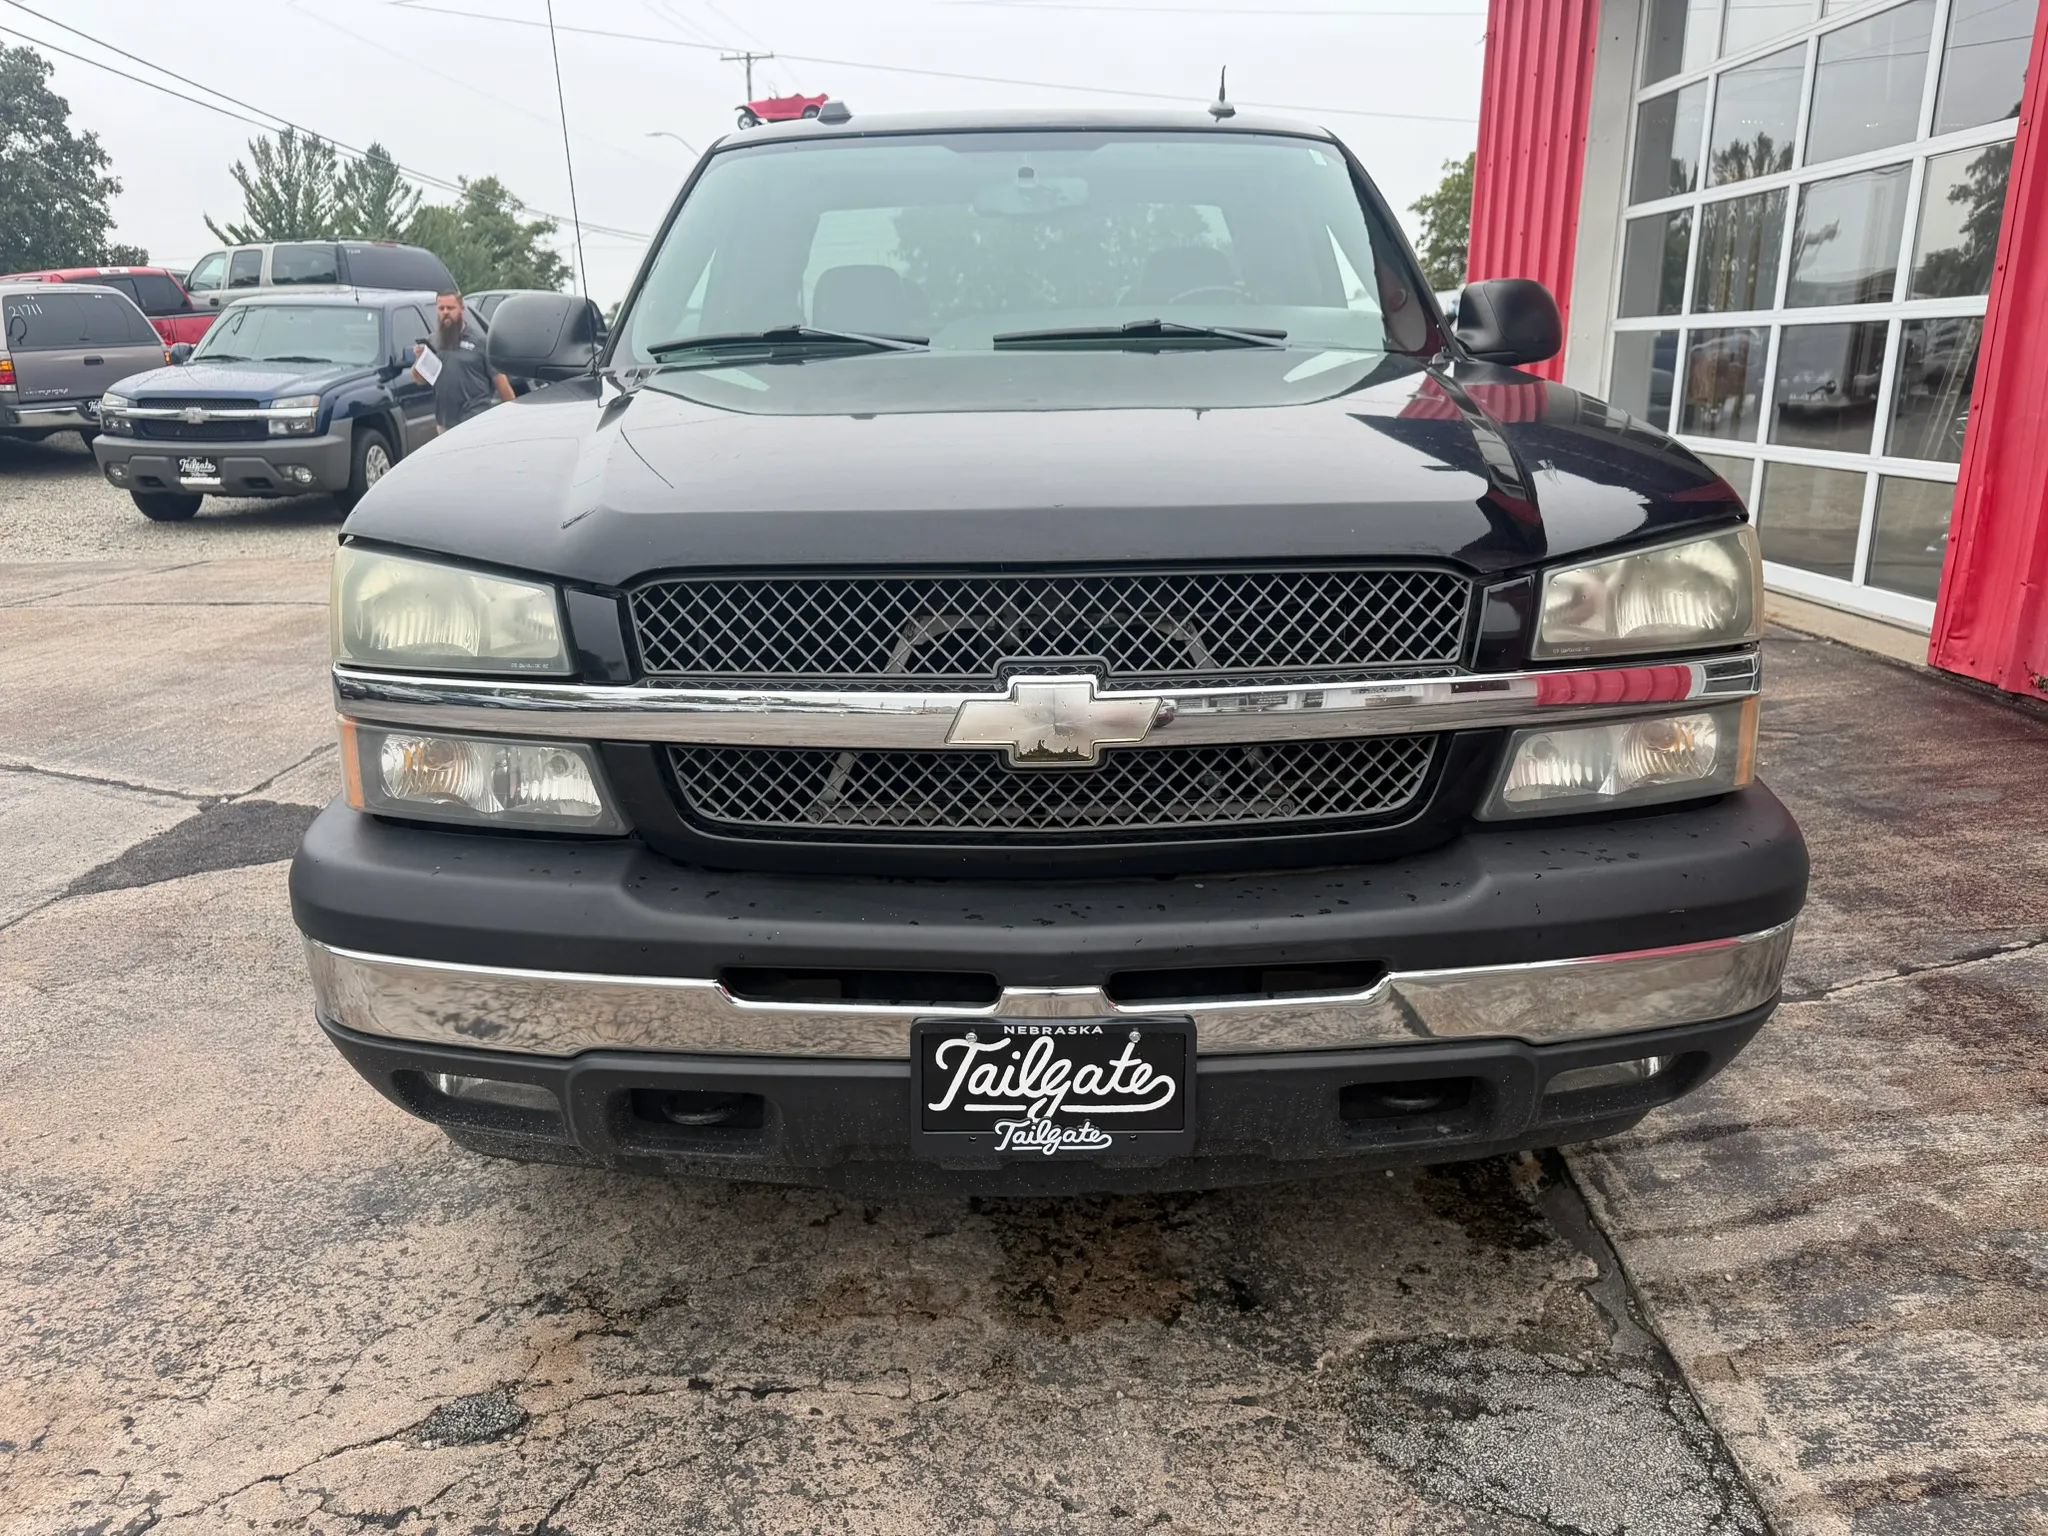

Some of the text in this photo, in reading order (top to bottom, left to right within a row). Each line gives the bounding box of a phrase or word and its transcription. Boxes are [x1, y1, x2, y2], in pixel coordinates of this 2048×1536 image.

[1003, 1025, 1104, 1035] NEBRASKA
[928, 1035, 1176, 1122] Tailgate
[994, 1119, 1113, 1156] Tailgate
